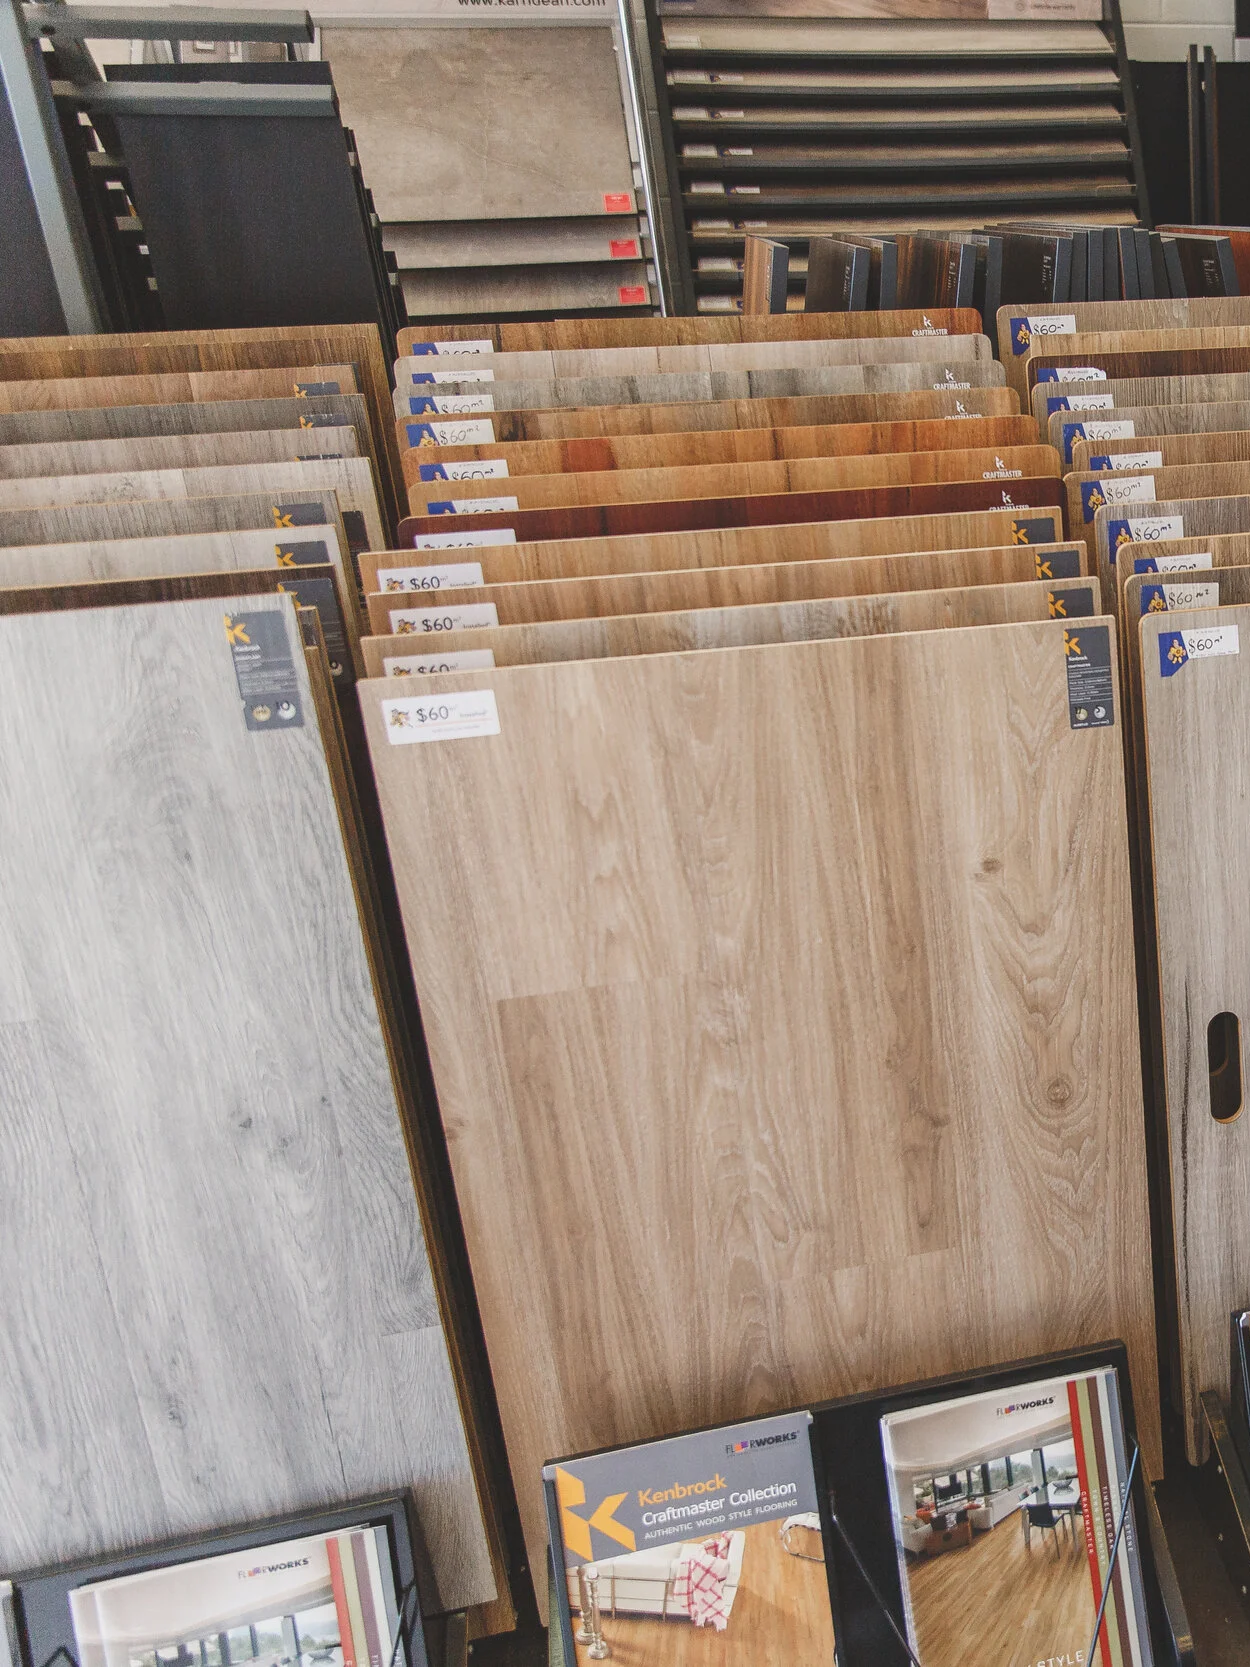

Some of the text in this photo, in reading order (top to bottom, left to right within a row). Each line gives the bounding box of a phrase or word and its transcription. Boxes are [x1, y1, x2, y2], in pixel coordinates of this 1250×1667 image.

[912, 328, 948, 336] CRAFTMASTER
[933, 382, 971, 390] CRAFTMASTER
[983, 470, 1022, 479] CRAFTMASTER
[638, 1473, 728, 1507] Kenbrock
[642, 1482, 797, 1526] Craftmaster Collection
[1102, 1486, 1112, 1528] TIMELESS
[644, 1499, 798, 1540] AUTHENTIC WOOD STYLE FLOORING
[1081, 1491, 1094, 1553] CRAFTMASTER
[1036, 1650, 1084, 1667] STYLE
